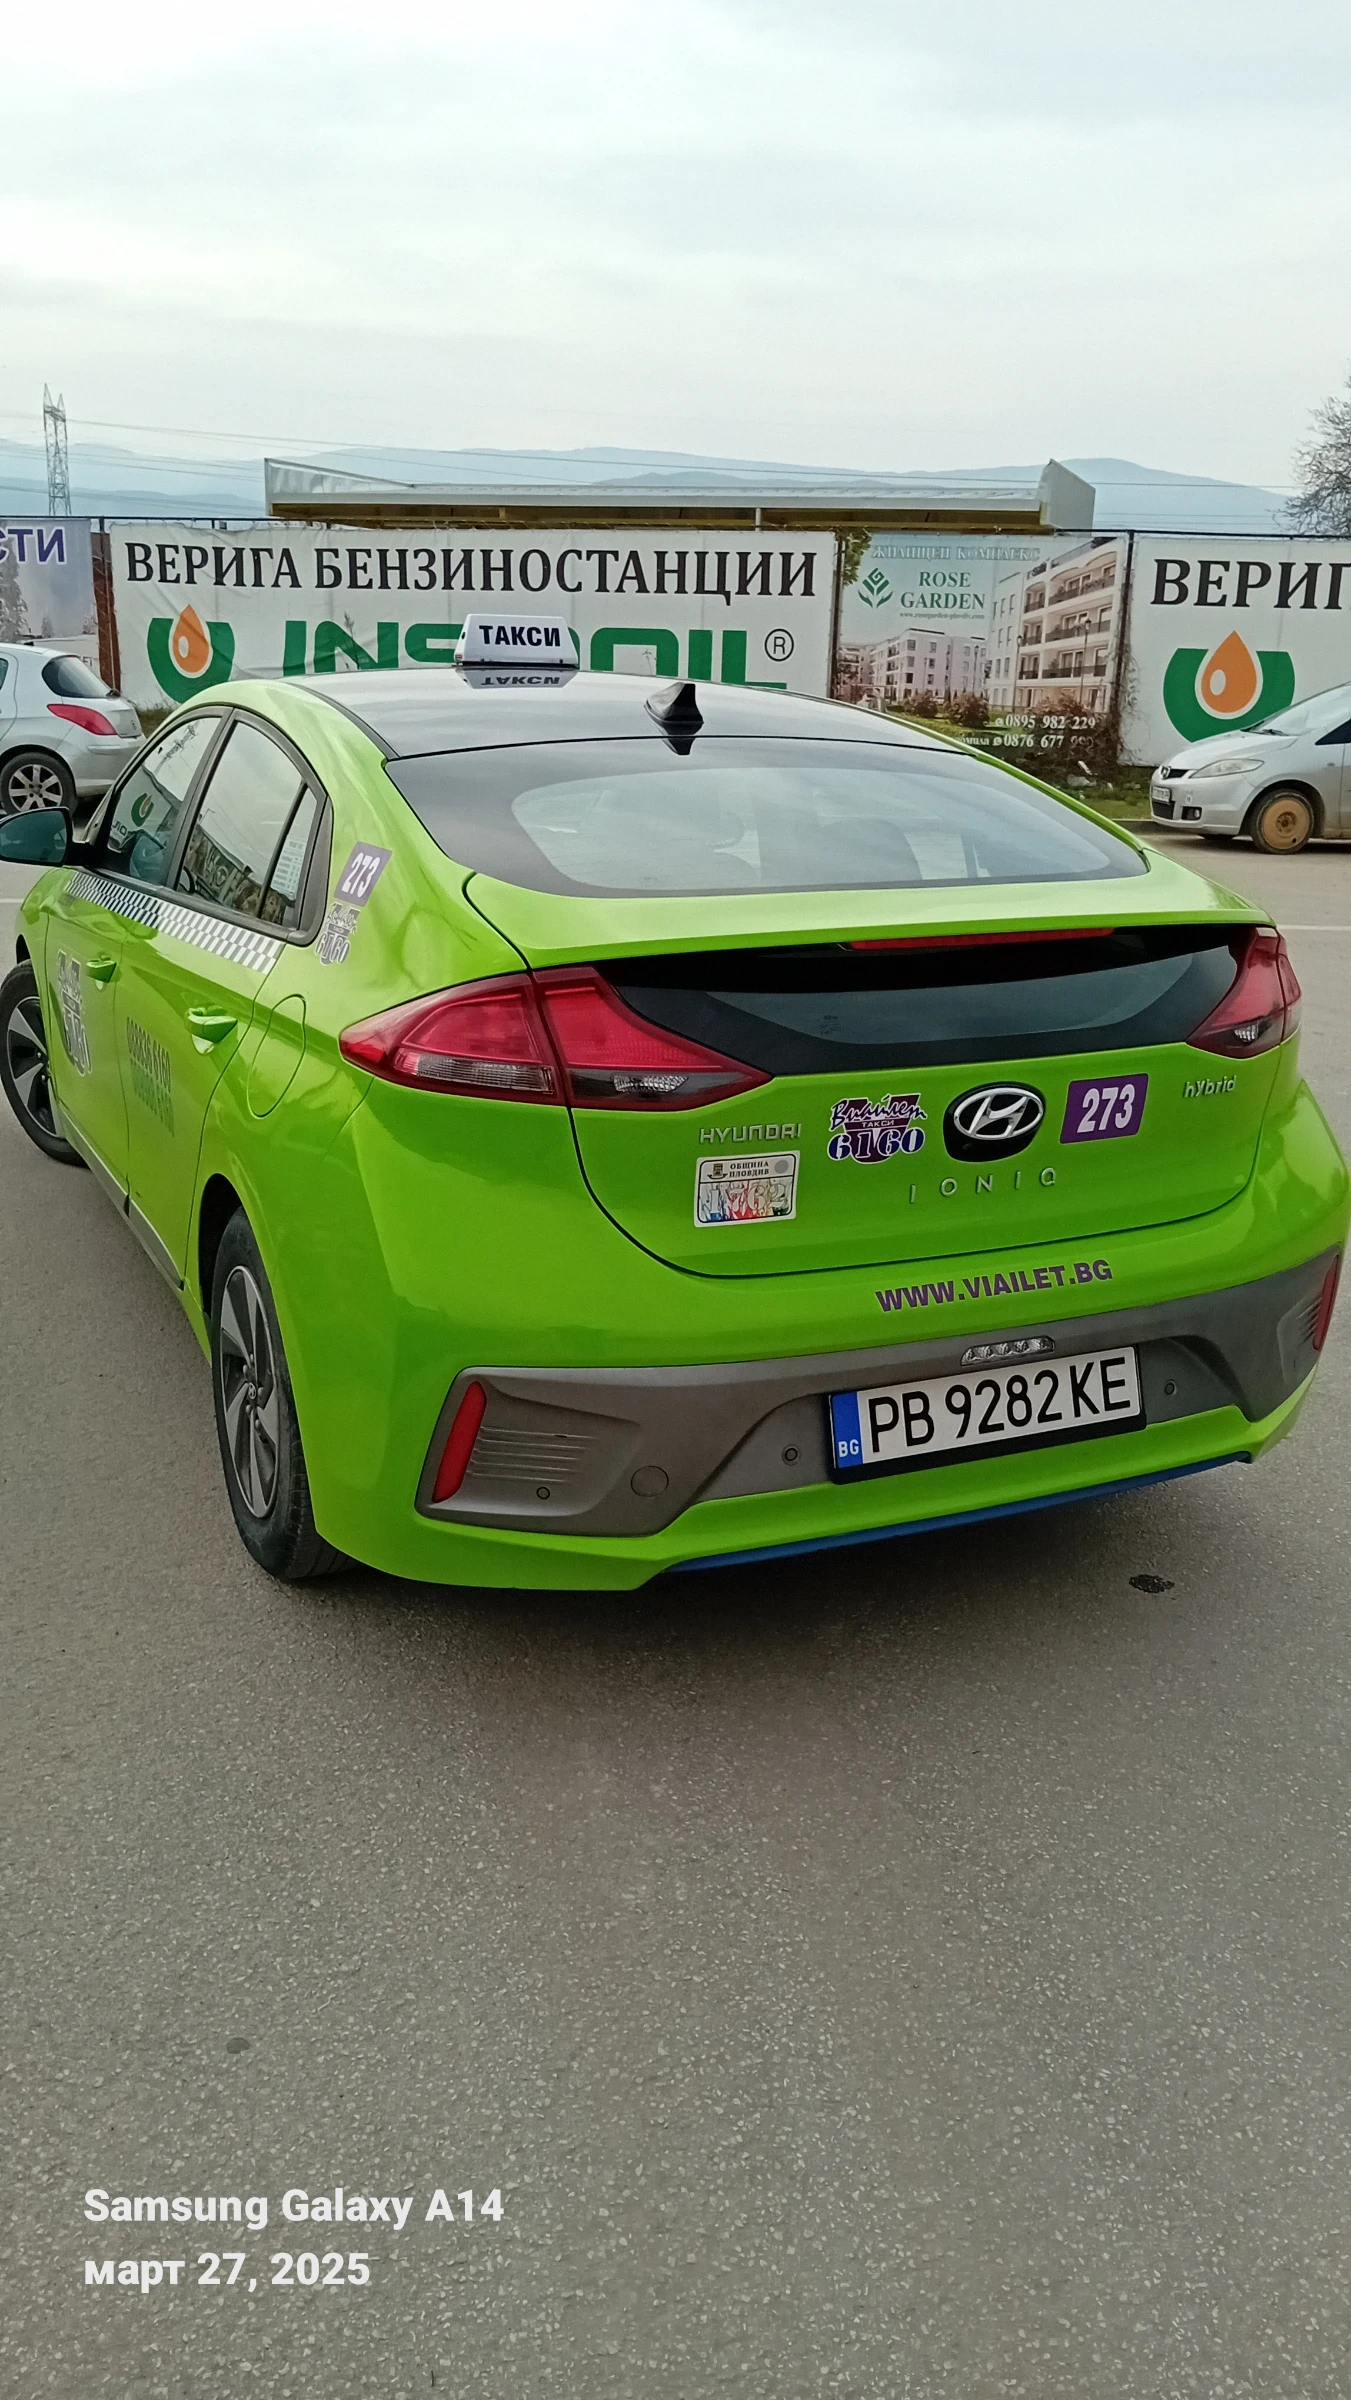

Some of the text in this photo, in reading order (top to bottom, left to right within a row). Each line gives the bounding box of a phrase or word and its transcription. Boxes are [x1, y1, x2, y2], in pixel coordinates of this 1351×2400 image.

[956, 547, 1041, 561] КОМПЛЕКС
[125, 542, 817, 606] ВЕРИГА БЕНЗИНОСТАНЦИИ
[919, 571, 971, 588] ROSE
[900, 592, 985, 610] GARDEN
[478, 624, 561, 647] ТАКСИ
[283, 620, 787, 689] INSOIL
[1005, 715, 1035, 729] 0895
[1003, 734, 1034, 747] 0876
[1040, 735, 1064, 748] 677
[341, 852, 381, 898] 273
[1076, 1083, 1136, 1133] 273
[699, 1123, 802, 1144] HYUNDAI
[861, 1119, 895, 1128] ТАКСИ
[828, 1128, 925, 1160] 6160
[729, 1160, 770, 1170] ОБЩИНА
[729, 1168, 770, 1178] ПЛОВДИВ
[909, 1167, 1057, 1204] IONIQ
[875, 1259, 1113, 1312] WWW.VIAILET.BG
[867, 1356, 1131, 1453] PB 9282 KE
[838, 1439, 860, 1458] BG
